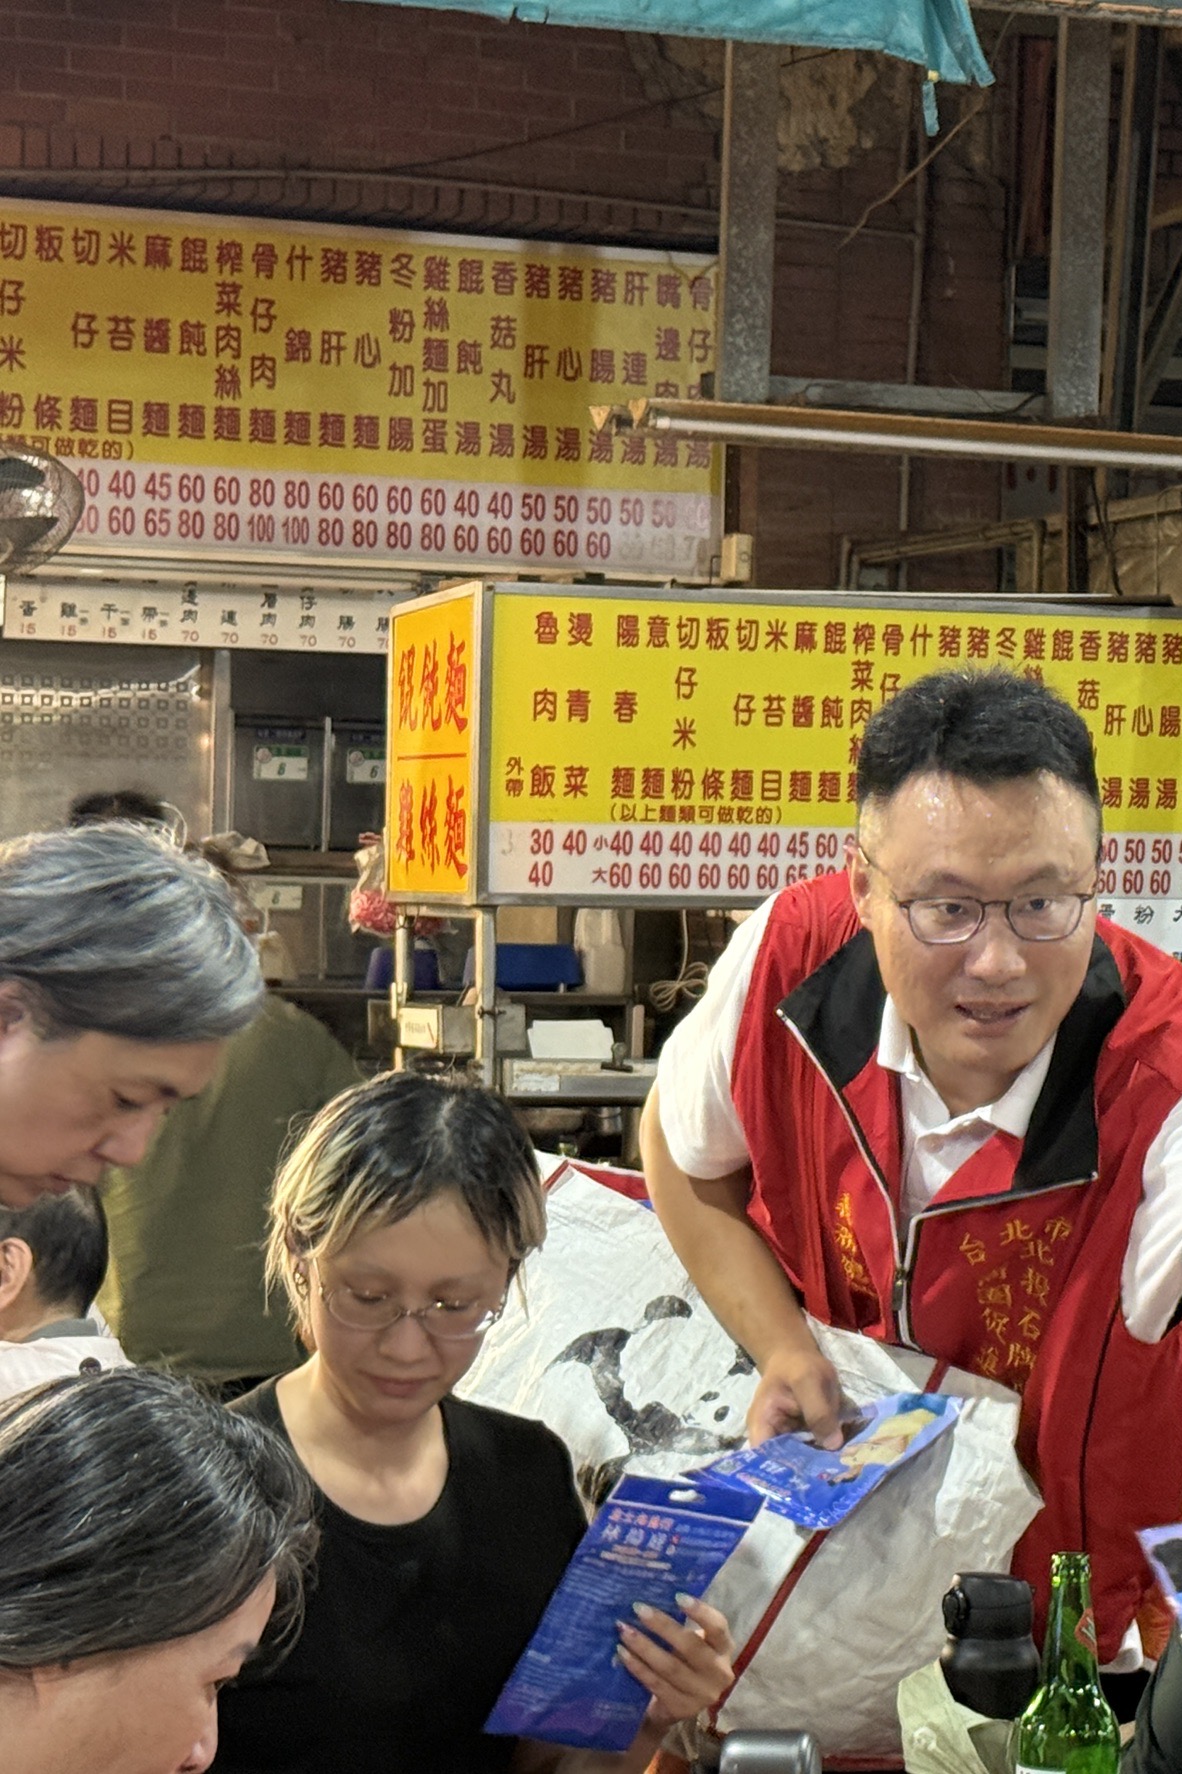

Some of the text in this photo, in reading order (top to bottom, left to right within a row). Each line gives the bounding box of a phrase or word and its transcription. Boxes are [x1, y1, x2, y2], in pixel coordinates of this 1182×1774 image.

[34, 225, 64, 432] 粄條
[70, 229, 101, 434] 切仔麵
[107, 230, 137, 435] 米苔目
[142, 235, 172, 438] 麻醬麵
[178, 237, 208, 440] 餛飩麵
[213, 239, 244, 442] 榨菜肉絲麵
[248, 243, 279, 444] 骨仔肉麵
[283, 244, 314, 446] 什錦麵
[318, 247, 348, 448] 豬肝麵
[352, 249, 383, 451] 豬心麵
[387, 252, 417, 453] 冬粉加腸
[421, 255, 450, 454] 雞絲麵加蛋
[455, 258, 484, 457] 餛飩湯
[488, 260, 517, 459] 香菇丸湯
[521, 263, 551, 461] 豬肝湯
[554, 265, 584, 463] 豬心湯
[588, 268, 617, 465] 豬腸湯
[621, 271, 649, 467] 肝連湯
[108, 470, 135, 499] 40
[144, 471, 171, 501] 45
[178, 473, 205, 503] 60
[213, 475, 240, 505] 60
[249, 478, 276, 507] 80
[284, 480, 310, 509] 80
[318, 482, 344, 511] 60
[352, 484, 378, 513] 60
[386, 486, 412, 515] 60
[421, 488, 446, 516] 60
[454, 489, 480, 518] 40
[487, 491, 513, 520] 40
[521, 493, 546, 522] 50
[554, 495, 579, 523] 50
[586, 497, 611, 525] 50
[620, 498, 644, 527] 50
[108, 506, 611, 559] 60 65 80 80 100 100 80 80 80 80 60 60 60 60 60
[20, 623, 356, 649] 15 15 15 15 70 70 70 70 70
[530, 611, 559, 798] 魯肉飯
[563, 612, 593, 798] 燙青菜
[611, 614, 640, 799] 陽春麵
[641, 615, 670, 800] 意麵
[671, 615, 700, 800] 切仔米粉
[702, 616, 730, 801] 粄條
[730, 618, 760, 801] 切仔麵
[760, 618, 788, 801] 米苔目
[788, 620, 818, 802] 麻醬麵
[818, 620, 847, 803] 餛飩麵
[910, 623, 933, 657] 什
[938, 625, 962, 658] 豬
[967, 626, 990, 659] 豬
[1102, 631, 1130, 808] 豬肝湯
[1128, 632, 1157, 809] 豬心湯
[505, 756, 524, 797] 外帶
[530, 828, 838, 859] 30 40 小 40 40 40 40 40 40 45 60
[610, 803, 782, 825] (以上麵類可做乾的)
[1124, 838, 1146, 864] 50
[1151, 839, 1172, 864] 50
[529, 861, 553, 887] 40
[592, 867, 607, 883] 大
[609, 862, 632, 888] 60
[639, 862, 662, 889] 60
[669, 863, 691, 889] 60
[699, 863, 721, 889] 60
[728, 864, 750, 890] 60
[757, 864, 779, 890] 60
[1123, 870, 1144, 894] 60
[1150, 870, 1171, 895] 60
